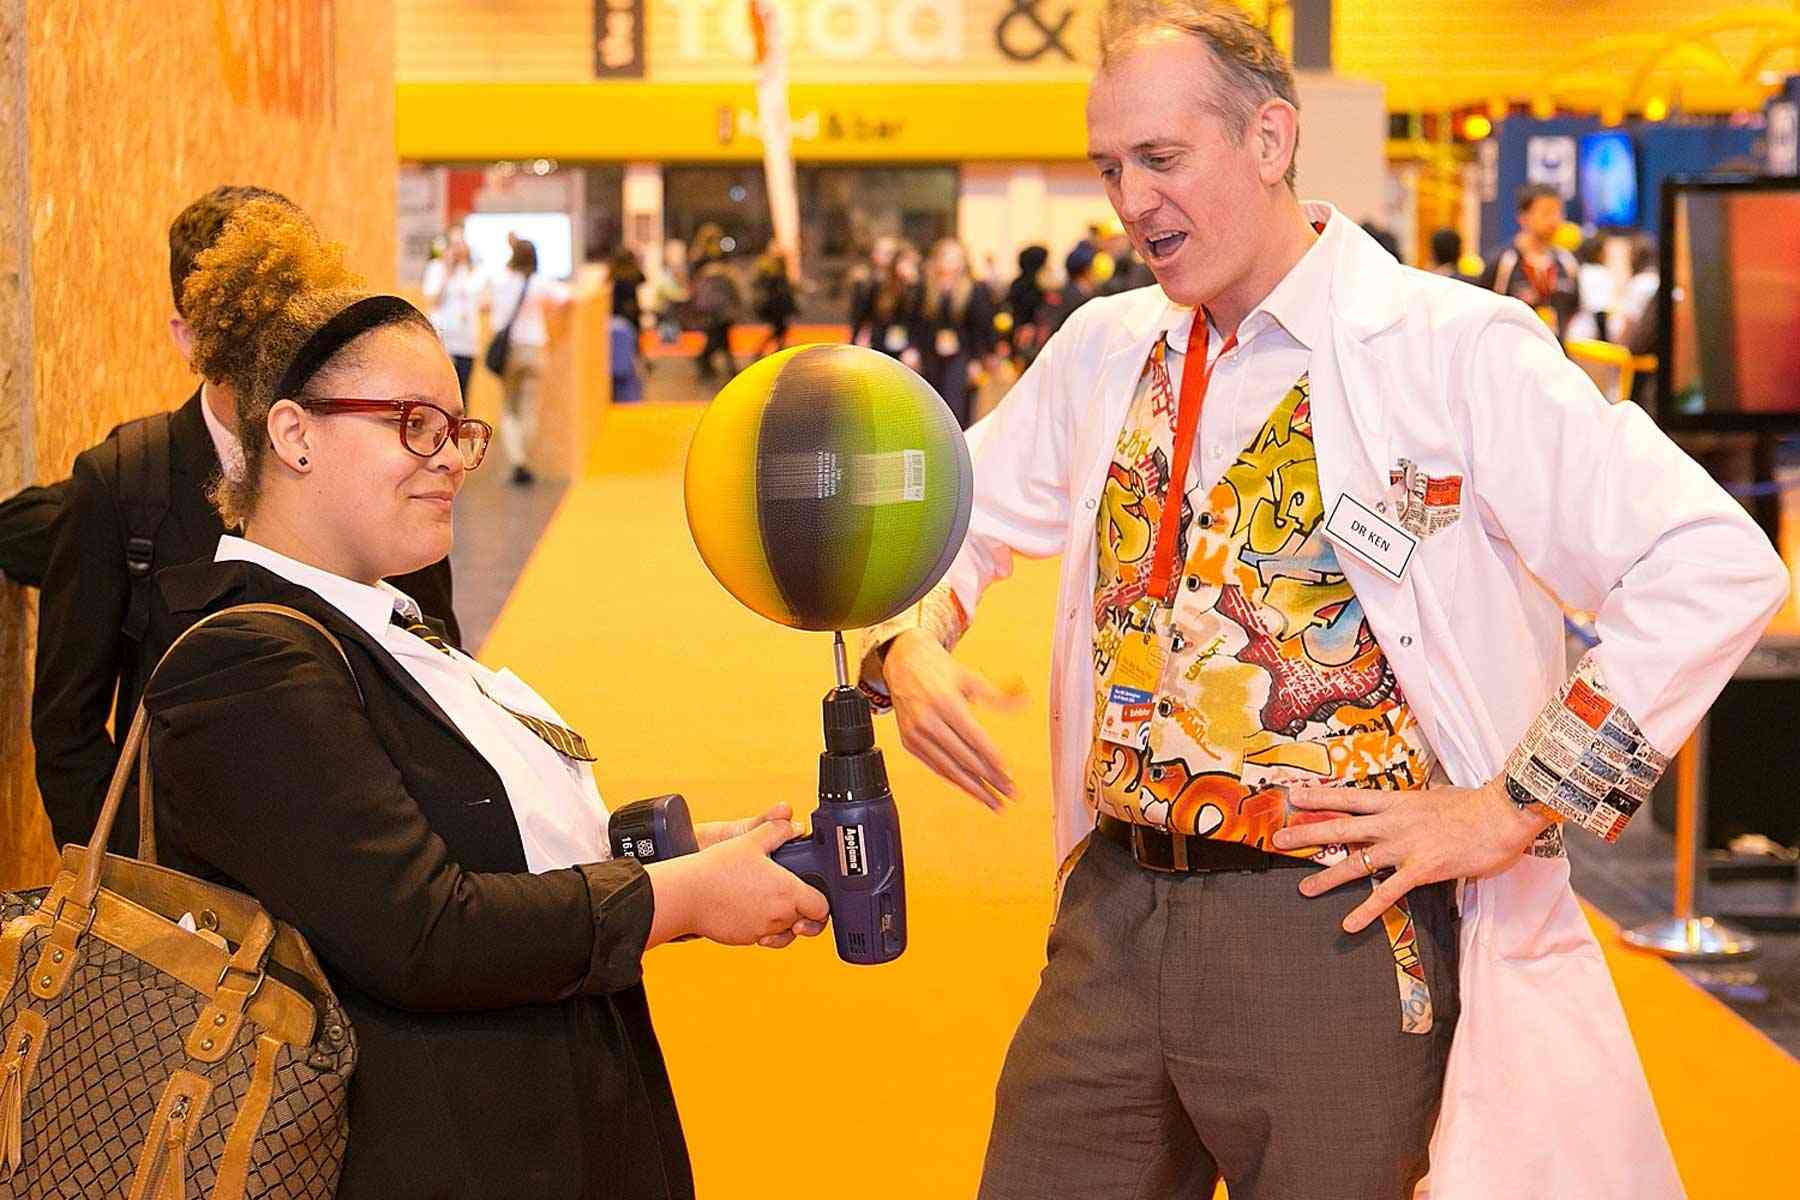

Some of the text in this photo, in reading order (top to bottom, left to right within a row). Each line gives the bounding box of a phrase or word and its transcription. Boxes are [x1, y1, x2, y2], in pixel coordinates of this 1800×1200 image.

[993, 0, 1076, 62] &
[1350, 520, 1390, 552] DR KEN
